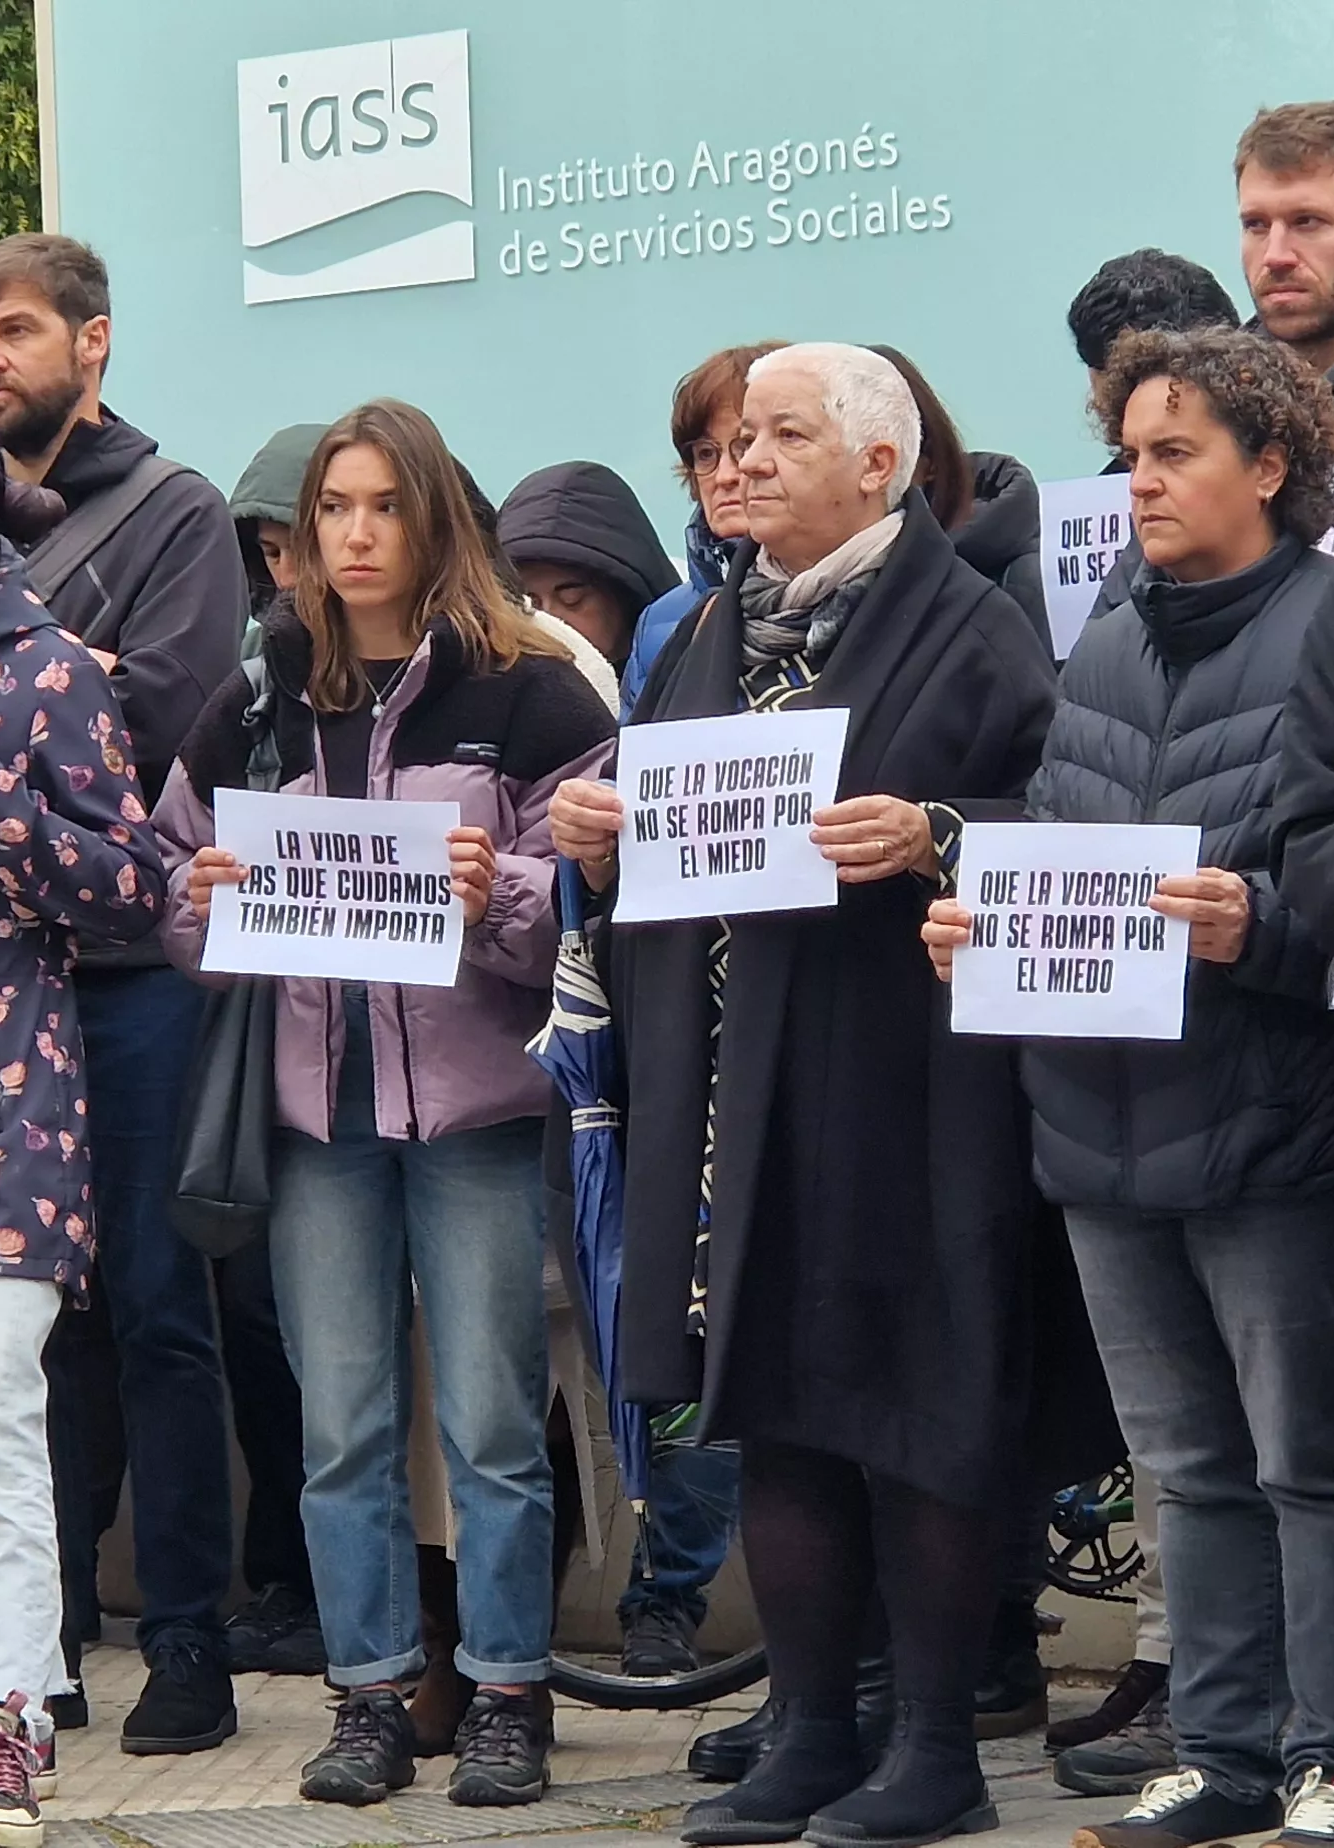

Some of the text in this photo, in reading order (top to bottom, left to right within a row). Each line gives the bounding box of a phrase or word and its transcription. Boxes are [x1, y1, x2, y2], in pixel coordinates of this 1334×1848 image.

[268, 75, 438, 164] iass
[498, 122, 899, 211] Instituto Aragonés
[499, 187, 952, 276] de Servicios Sociales
[1061, 516, 1093, 550] QUE
[1100, 513, 1120, 544] LA
[1057, 554, 1080, 586] NO
[1086, 550, 1107, 582] SE
[639, 747, 814, 802] QUE LA VOCACIÓN
[634, 792, 813, 842] NO SE ROMPA POR
[275, 829, 399, 865] LA VIDA DE
[680, 837, 766, 879] EL MIEDO
[286, 867, 327, 899] QUE
[338, 869, 451, 905] CUIDAMOS
[980, 870, 1020, 906] QUE
[1027, 871, 1052, 906] LA
[239, 900, 445, 944] TAMBIÉN IMPORTA
[972, 913, 1165, 951] NO SE ROMPA POR
[1017, 957, 1114, 994] EL MIEDO
